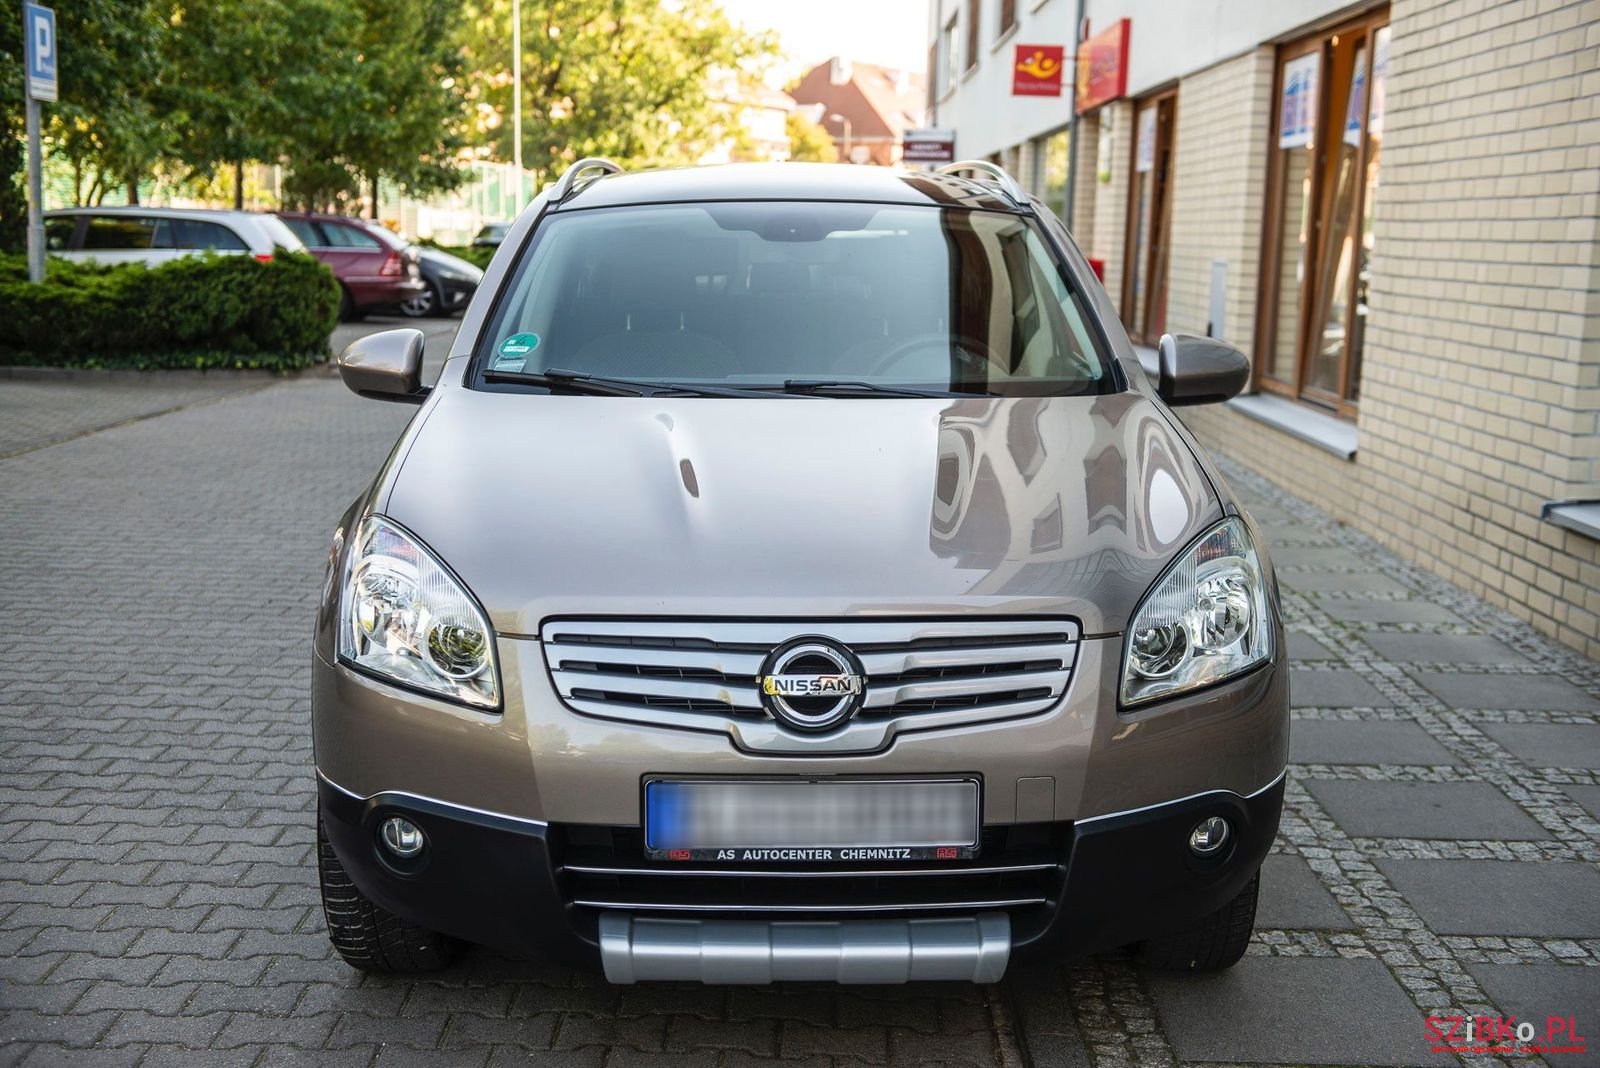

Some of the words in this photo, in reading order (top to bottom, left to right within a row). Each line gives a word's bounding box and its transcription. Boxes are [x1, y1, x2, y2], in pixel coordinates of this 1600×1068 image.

[34, 15, 52, 73] P
[774, 679, 852, 692] NISSAN
[717, 849, 736, 860] AS
[742, 849, 833, 860] AUTOCENTER
[839, 848, 911, 860] CHEMNITZ
